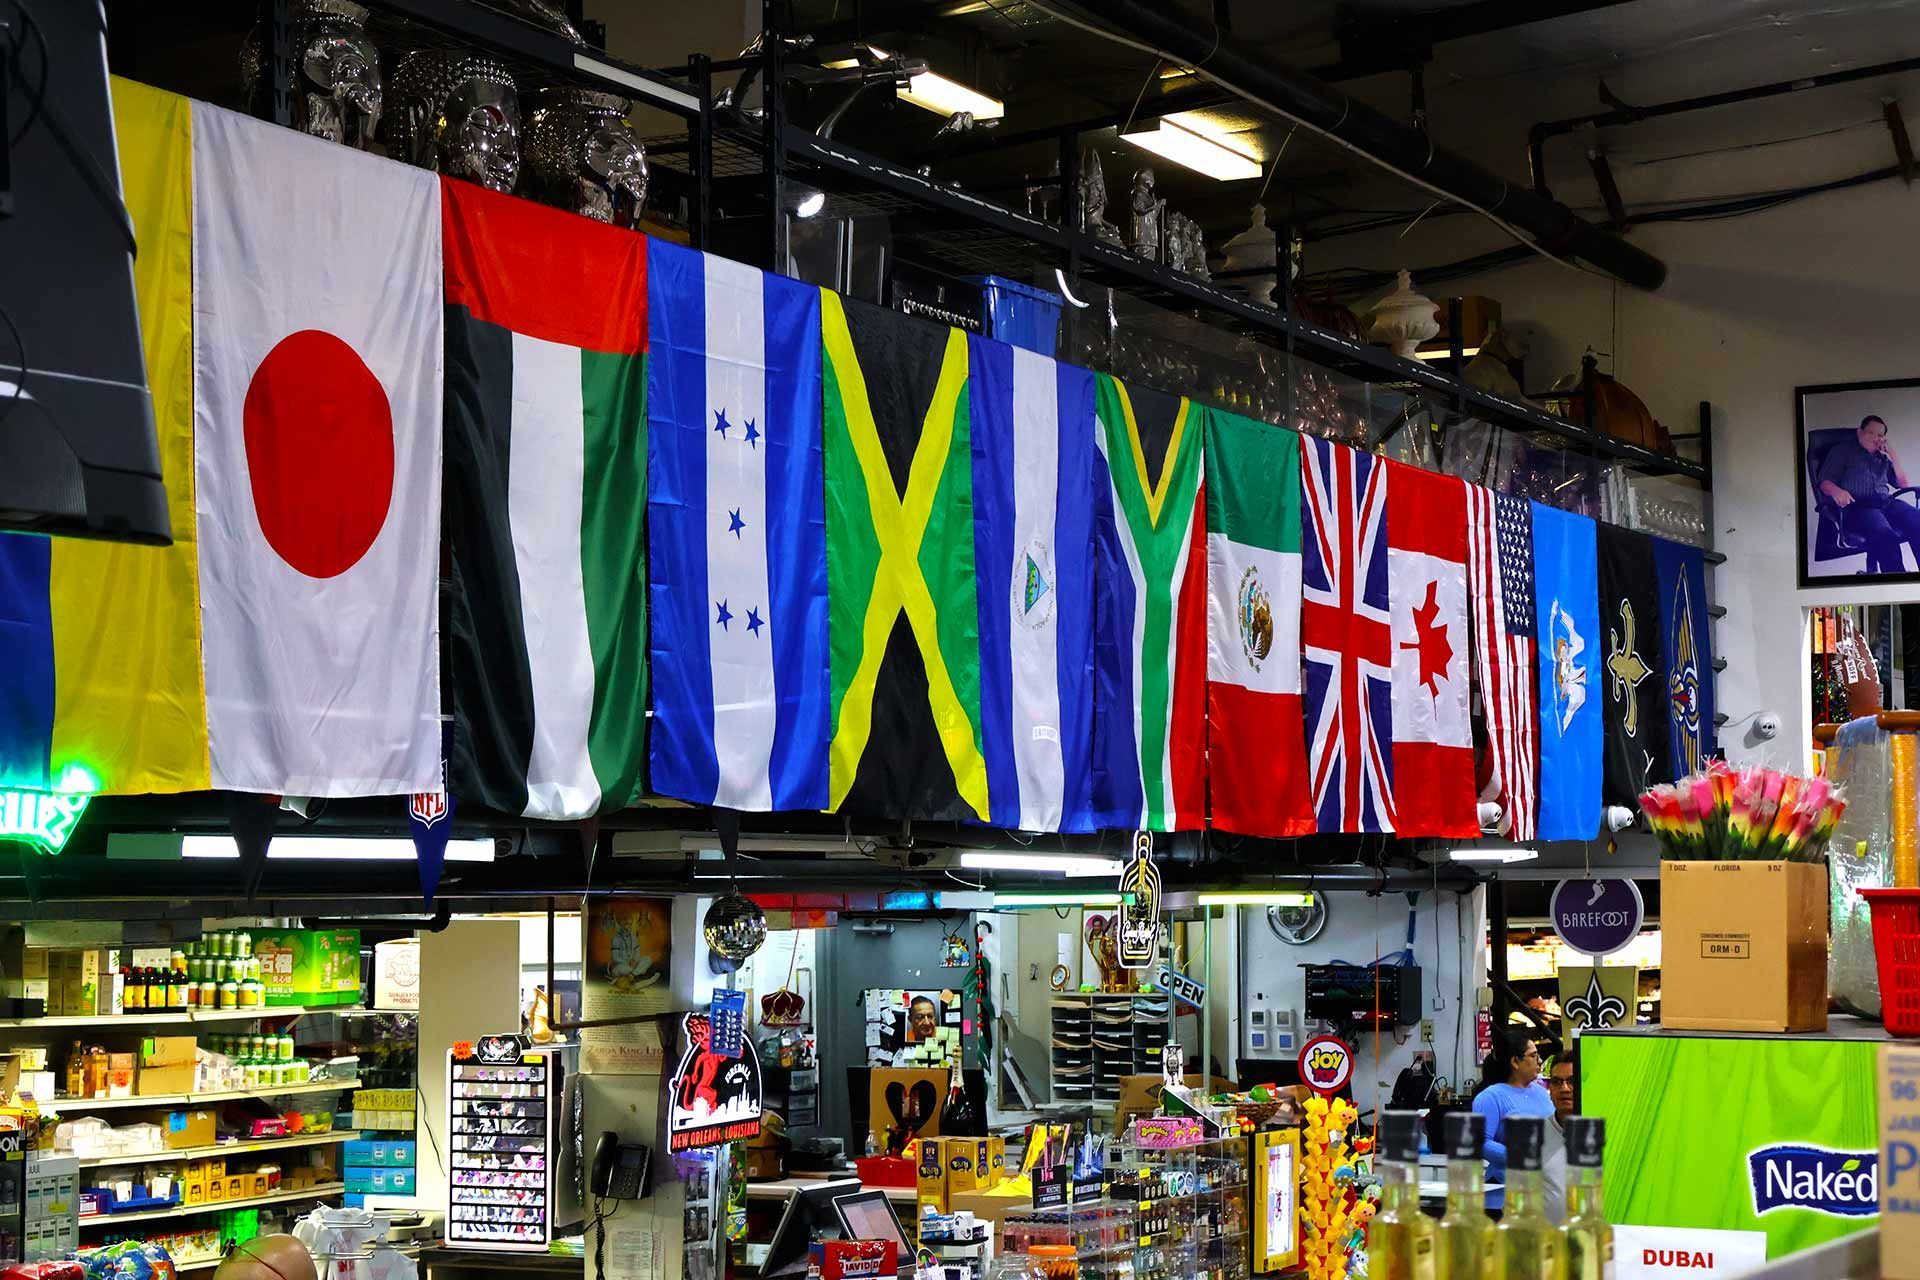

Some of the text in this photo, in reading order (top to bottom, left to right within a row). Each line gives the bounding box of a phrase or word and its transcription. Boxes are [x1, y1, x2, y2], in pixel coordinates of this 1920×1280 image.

[413, 793, 444, 818] NFL
[1713, 864, 1741, 872] FLORIDA
[1562, 911, 1629, 928] BAREFOOT
[1160, 971, 1205, 1005] OPEN
[672, 1132, 689, 1149] NEW
[725, 1120, 760, 1140] LOUISIANA
[1765, 1158, 1878, 1202] Naked
[1642, 1248, 1714, 1269] DUBAI
